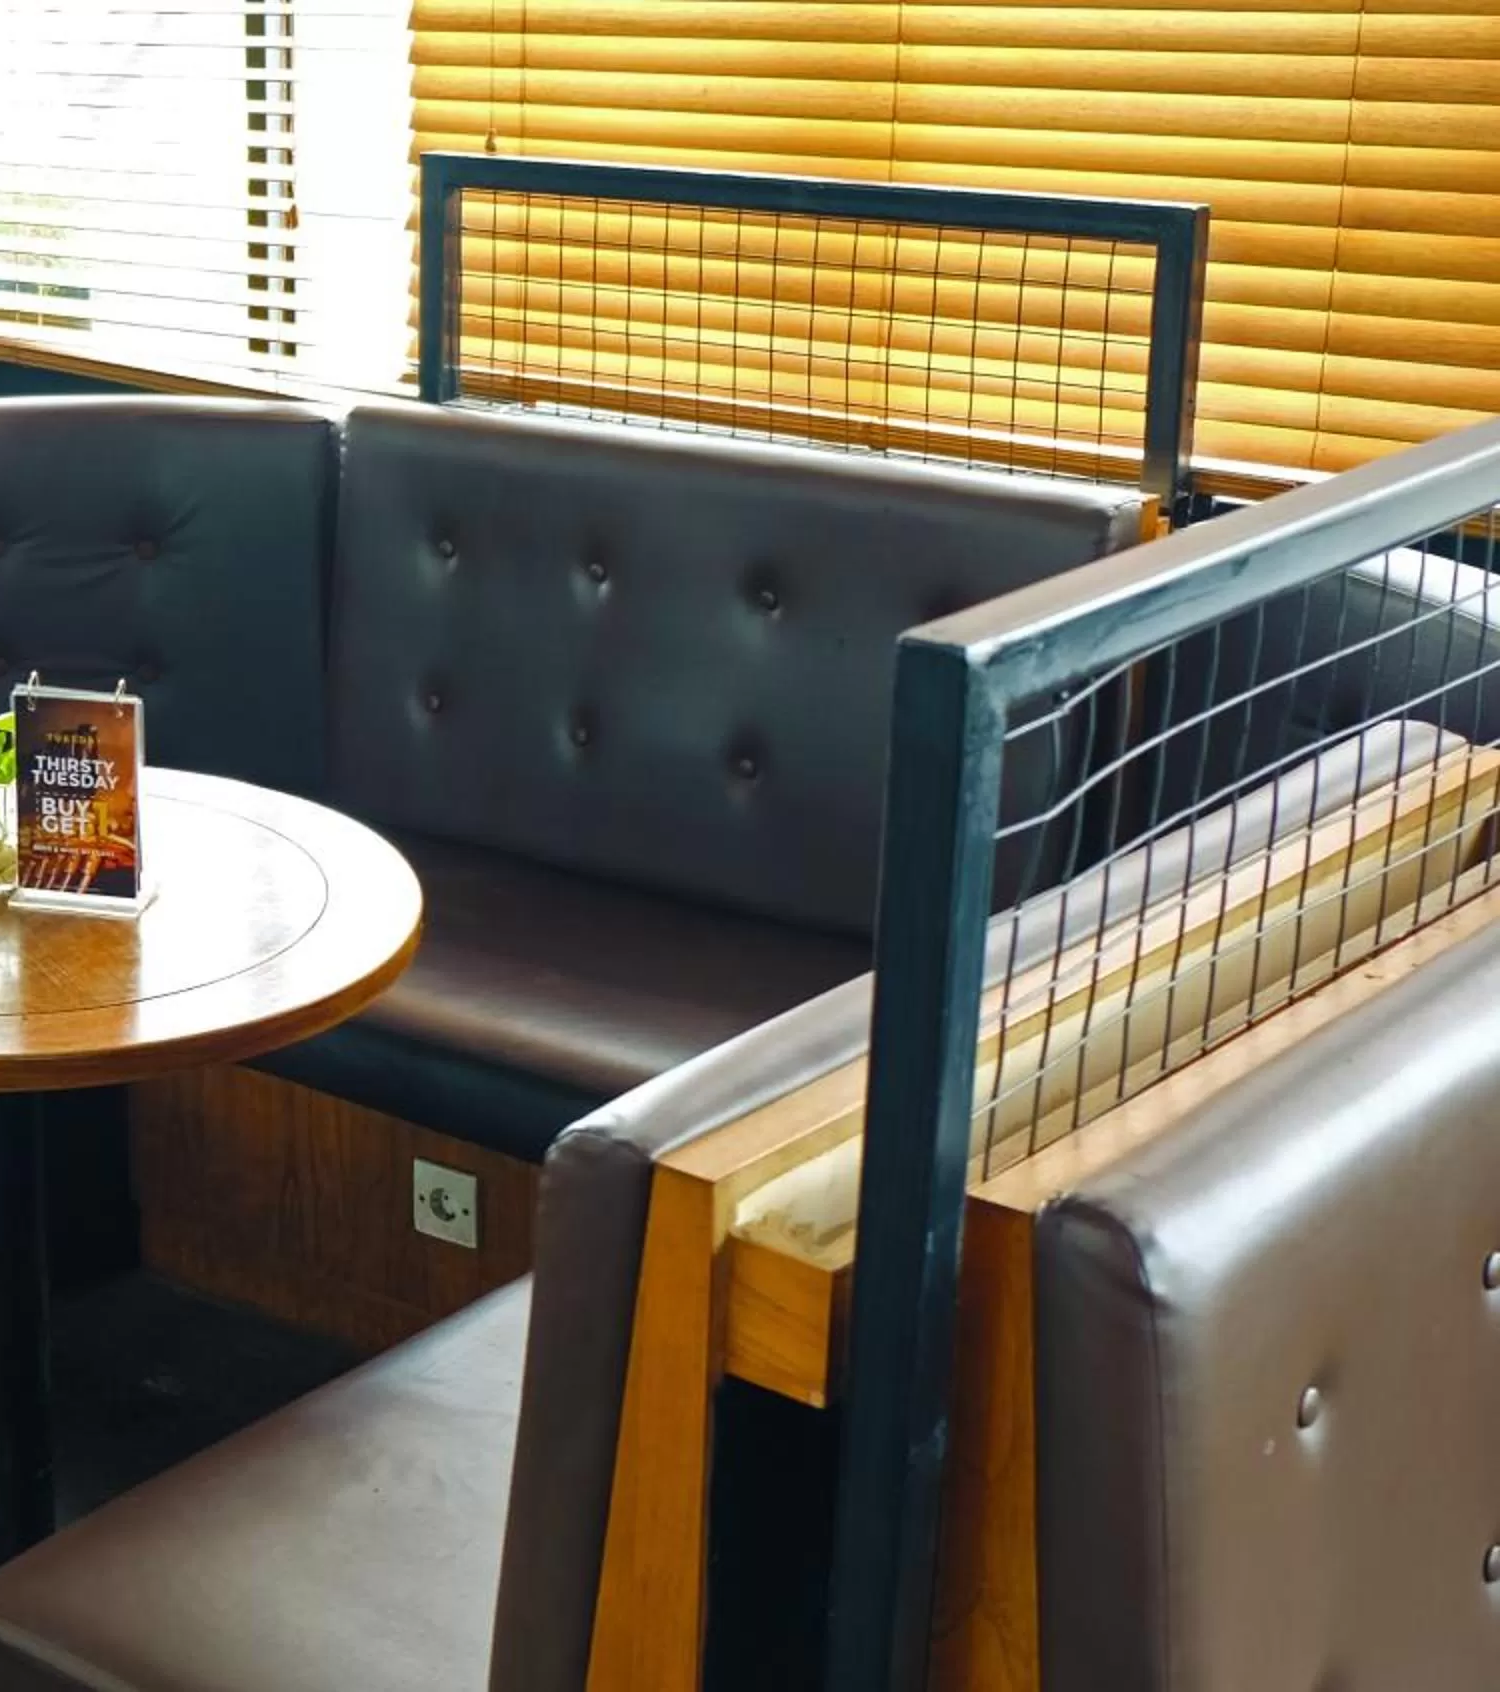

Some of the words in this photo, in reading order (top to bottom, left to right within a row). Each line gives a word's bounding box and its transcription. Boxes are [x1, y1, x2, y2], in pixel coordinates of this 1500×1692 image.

[35, 755, 115, 775] THIRSTY
[32, 769, 119, 791] TUESDAY
[41, 797, 91, 817] BUY
[41, 816, 89, 836] GET
